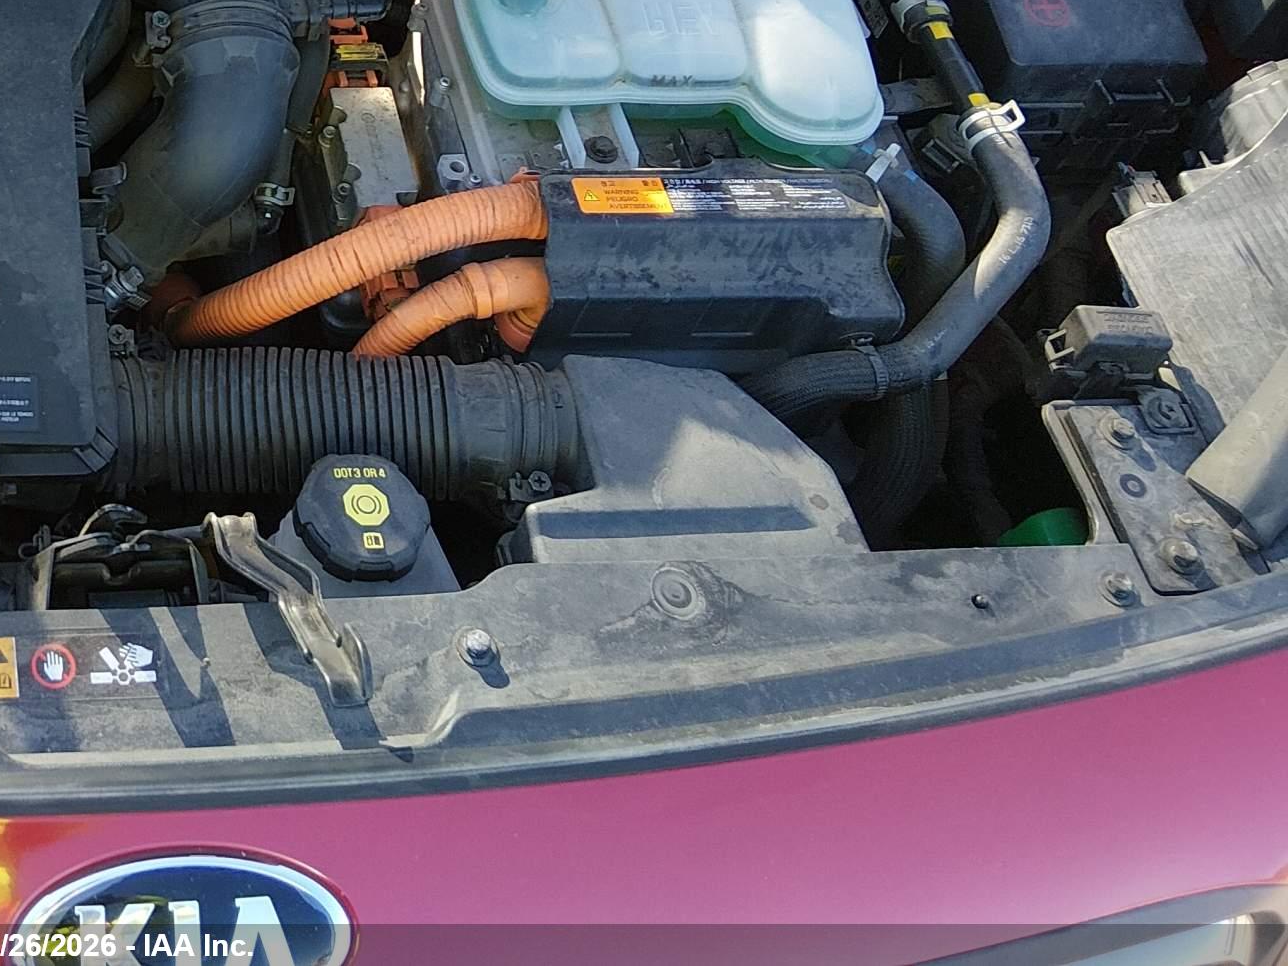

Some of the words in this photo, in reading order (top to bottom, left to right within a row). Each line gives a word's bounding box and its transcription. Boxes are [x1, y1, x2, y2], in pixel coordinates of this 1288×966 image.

[650, 74, 693, 87] MAX
[378, 468, 386, 478] 4
[74, 895, 296, 966] KIA
